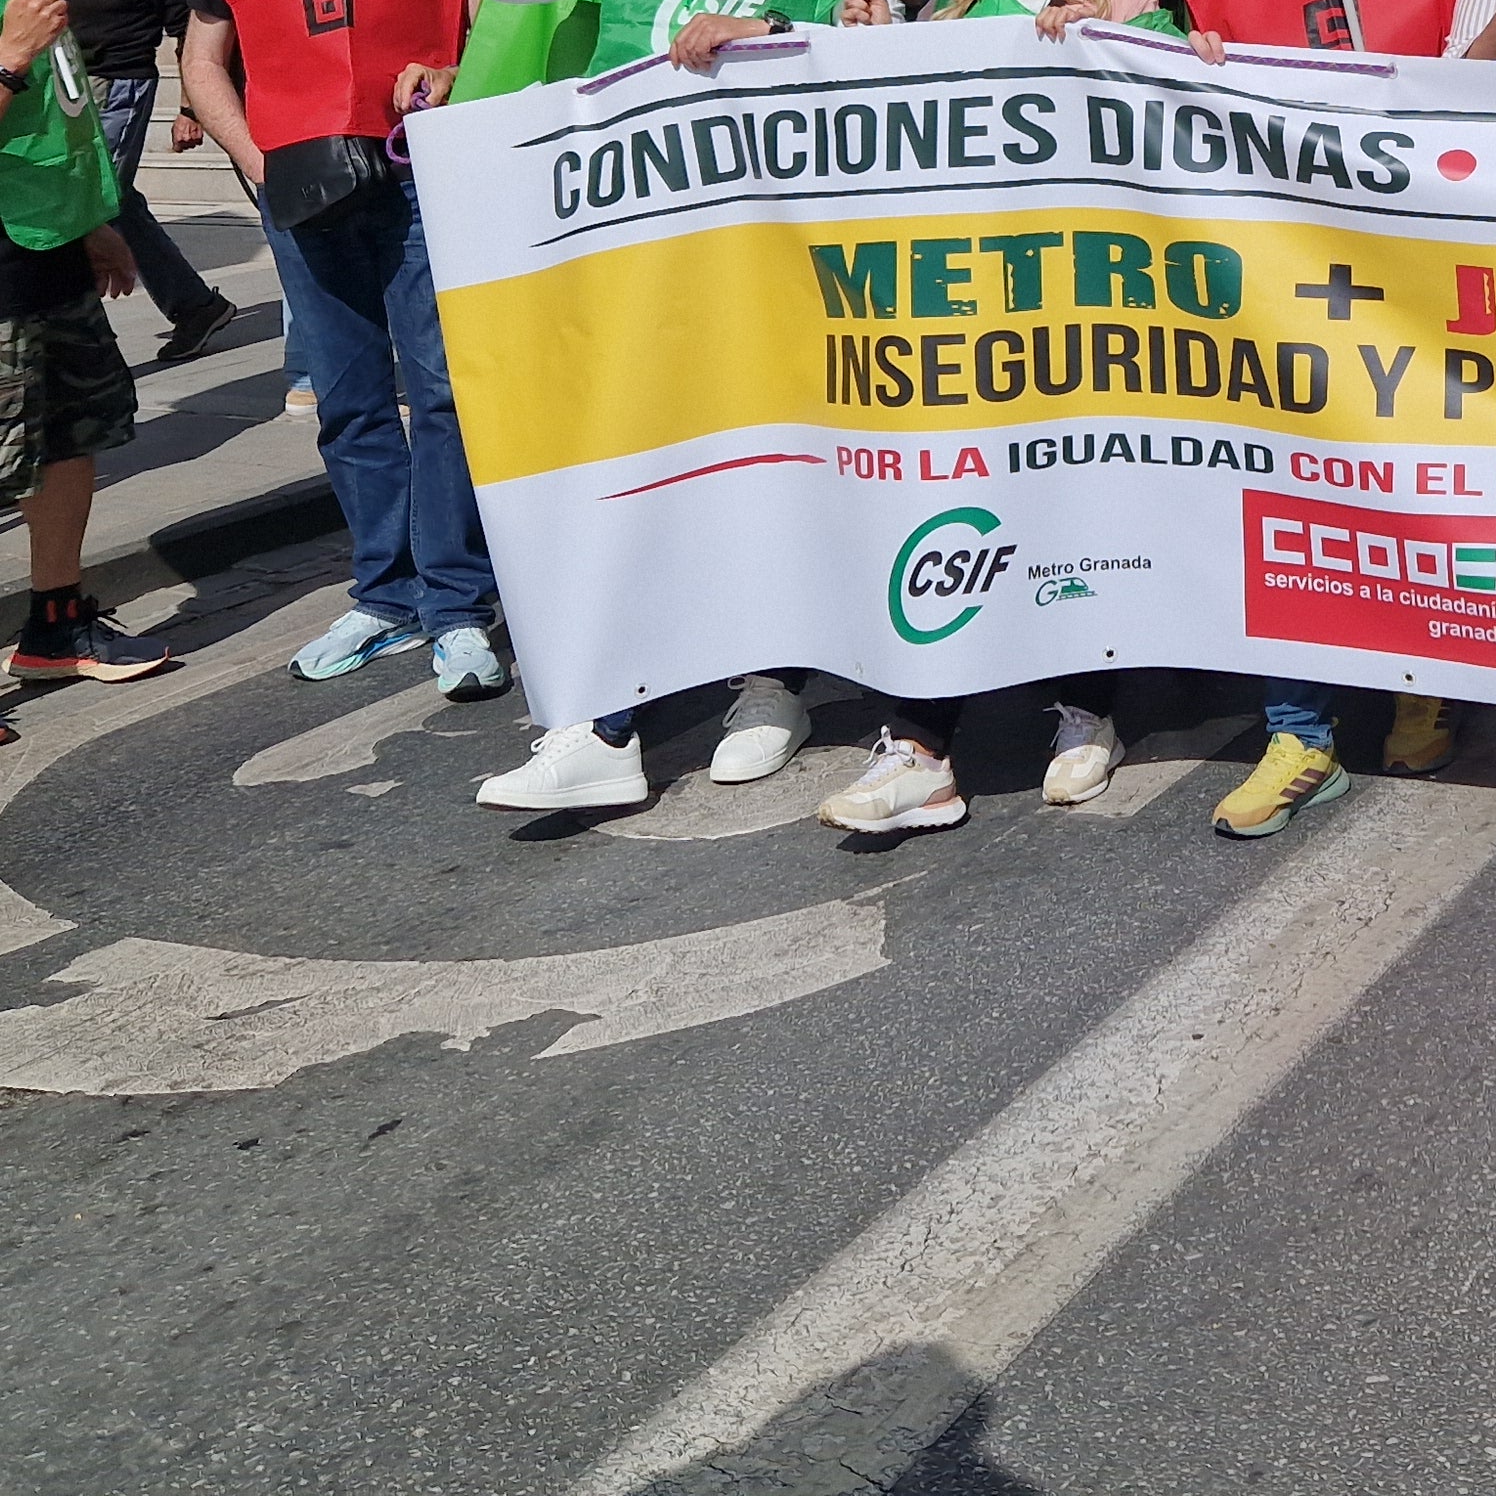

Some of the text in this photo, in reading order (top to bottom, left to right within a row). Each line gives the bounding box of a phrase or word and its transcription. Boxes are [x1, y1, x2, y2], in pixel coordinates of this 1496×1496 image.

[553, 93, 1058, 220] CONDICIONES
[1087, 95, 1415, 195] DIGNAS
[808, 231, 1243, 320] METRO
[826, 324, 1330, 414] INSEGURIDAD
[1359, 345, 1416, 419] Y
[836, 446, 903, 482] POR
[918, 446, 990, 480] LA
[1008, 434, 1275, 475] IGUALDAD
[1289, 452, 1394, 495] CON
[1415, 463, 1483, 498] EL
[908, 544, 1017, 598] CSIF
[1028, 555, 1152, 580] Metro Granada
[1264, 571, 1354, 596] servicios
[1359, 585, 1371, 599] a
[1375, 583, 1395, 603] la
